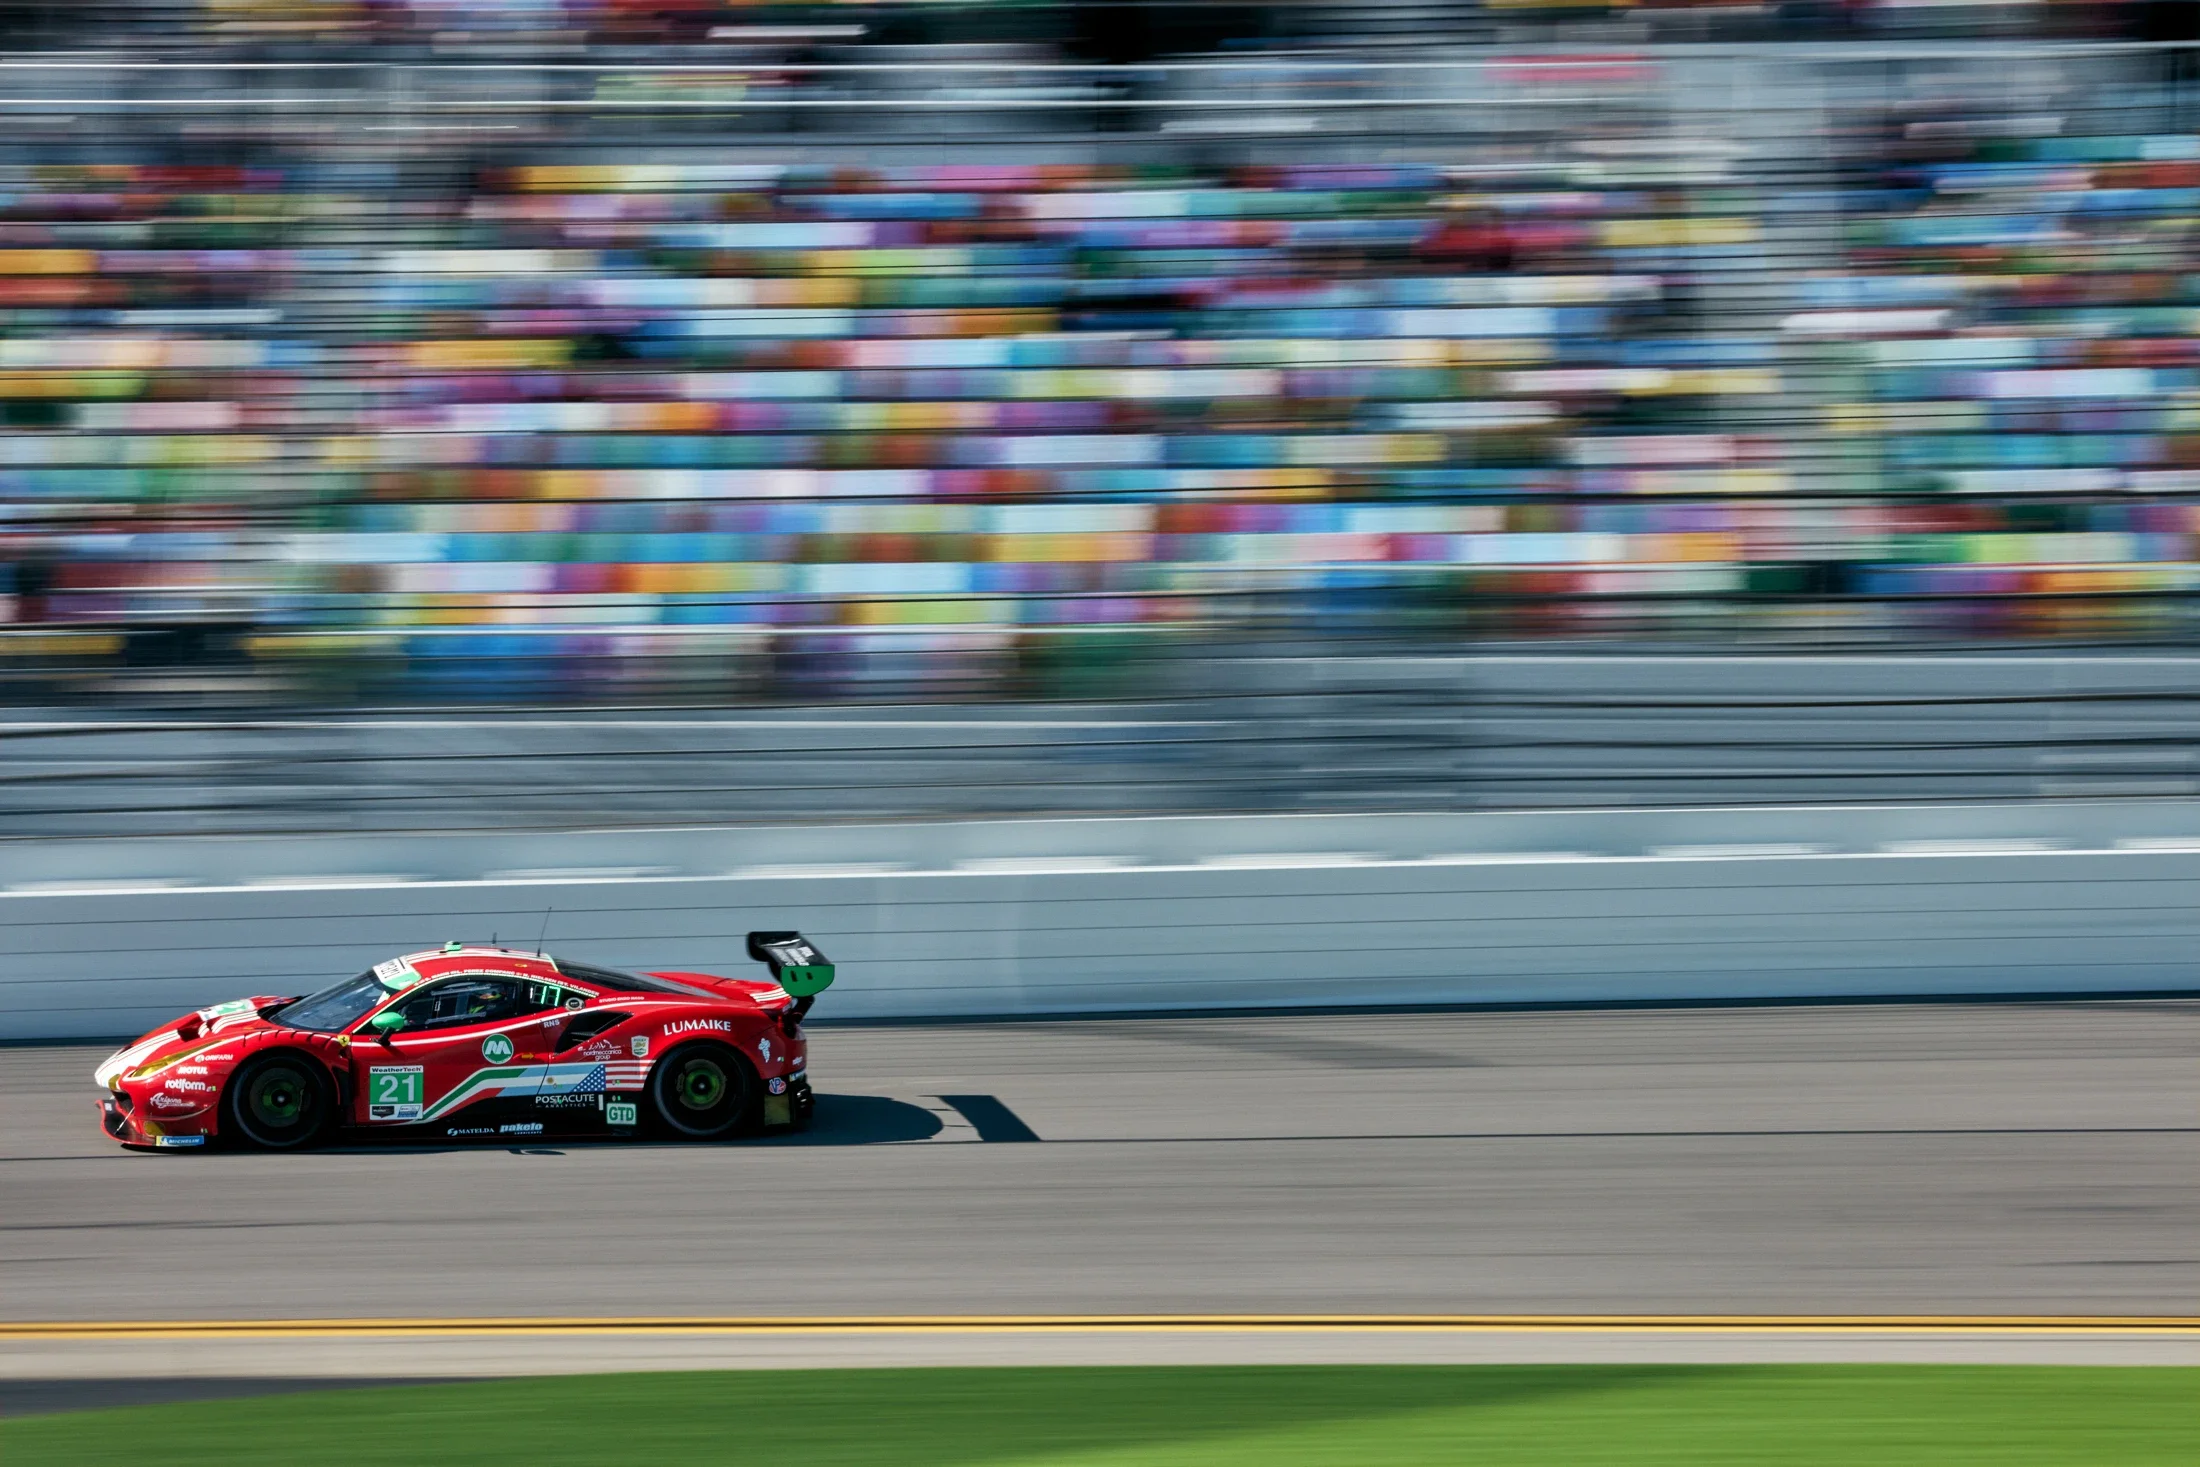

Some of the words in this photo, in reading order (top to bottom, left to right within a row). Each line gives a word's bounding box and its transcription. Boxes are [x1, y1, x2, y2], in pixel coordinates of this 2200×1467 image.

[569, 983, 600, 997] VILANDER
[543, 1018, 560, 1028] RNS
[663, 1019, 732, 1036] LUMAIKE
[177, 1066, 208, 1075] MOTUL
[165, 1079, 205, 1092] rotiform
[379, 1074, 414, 1102] 21
[535, 1093, 595, 1104] POSTACUTE
[608, 1106, 635, 1122] GTD
[500, 1122, 544, 1133] pakelo
